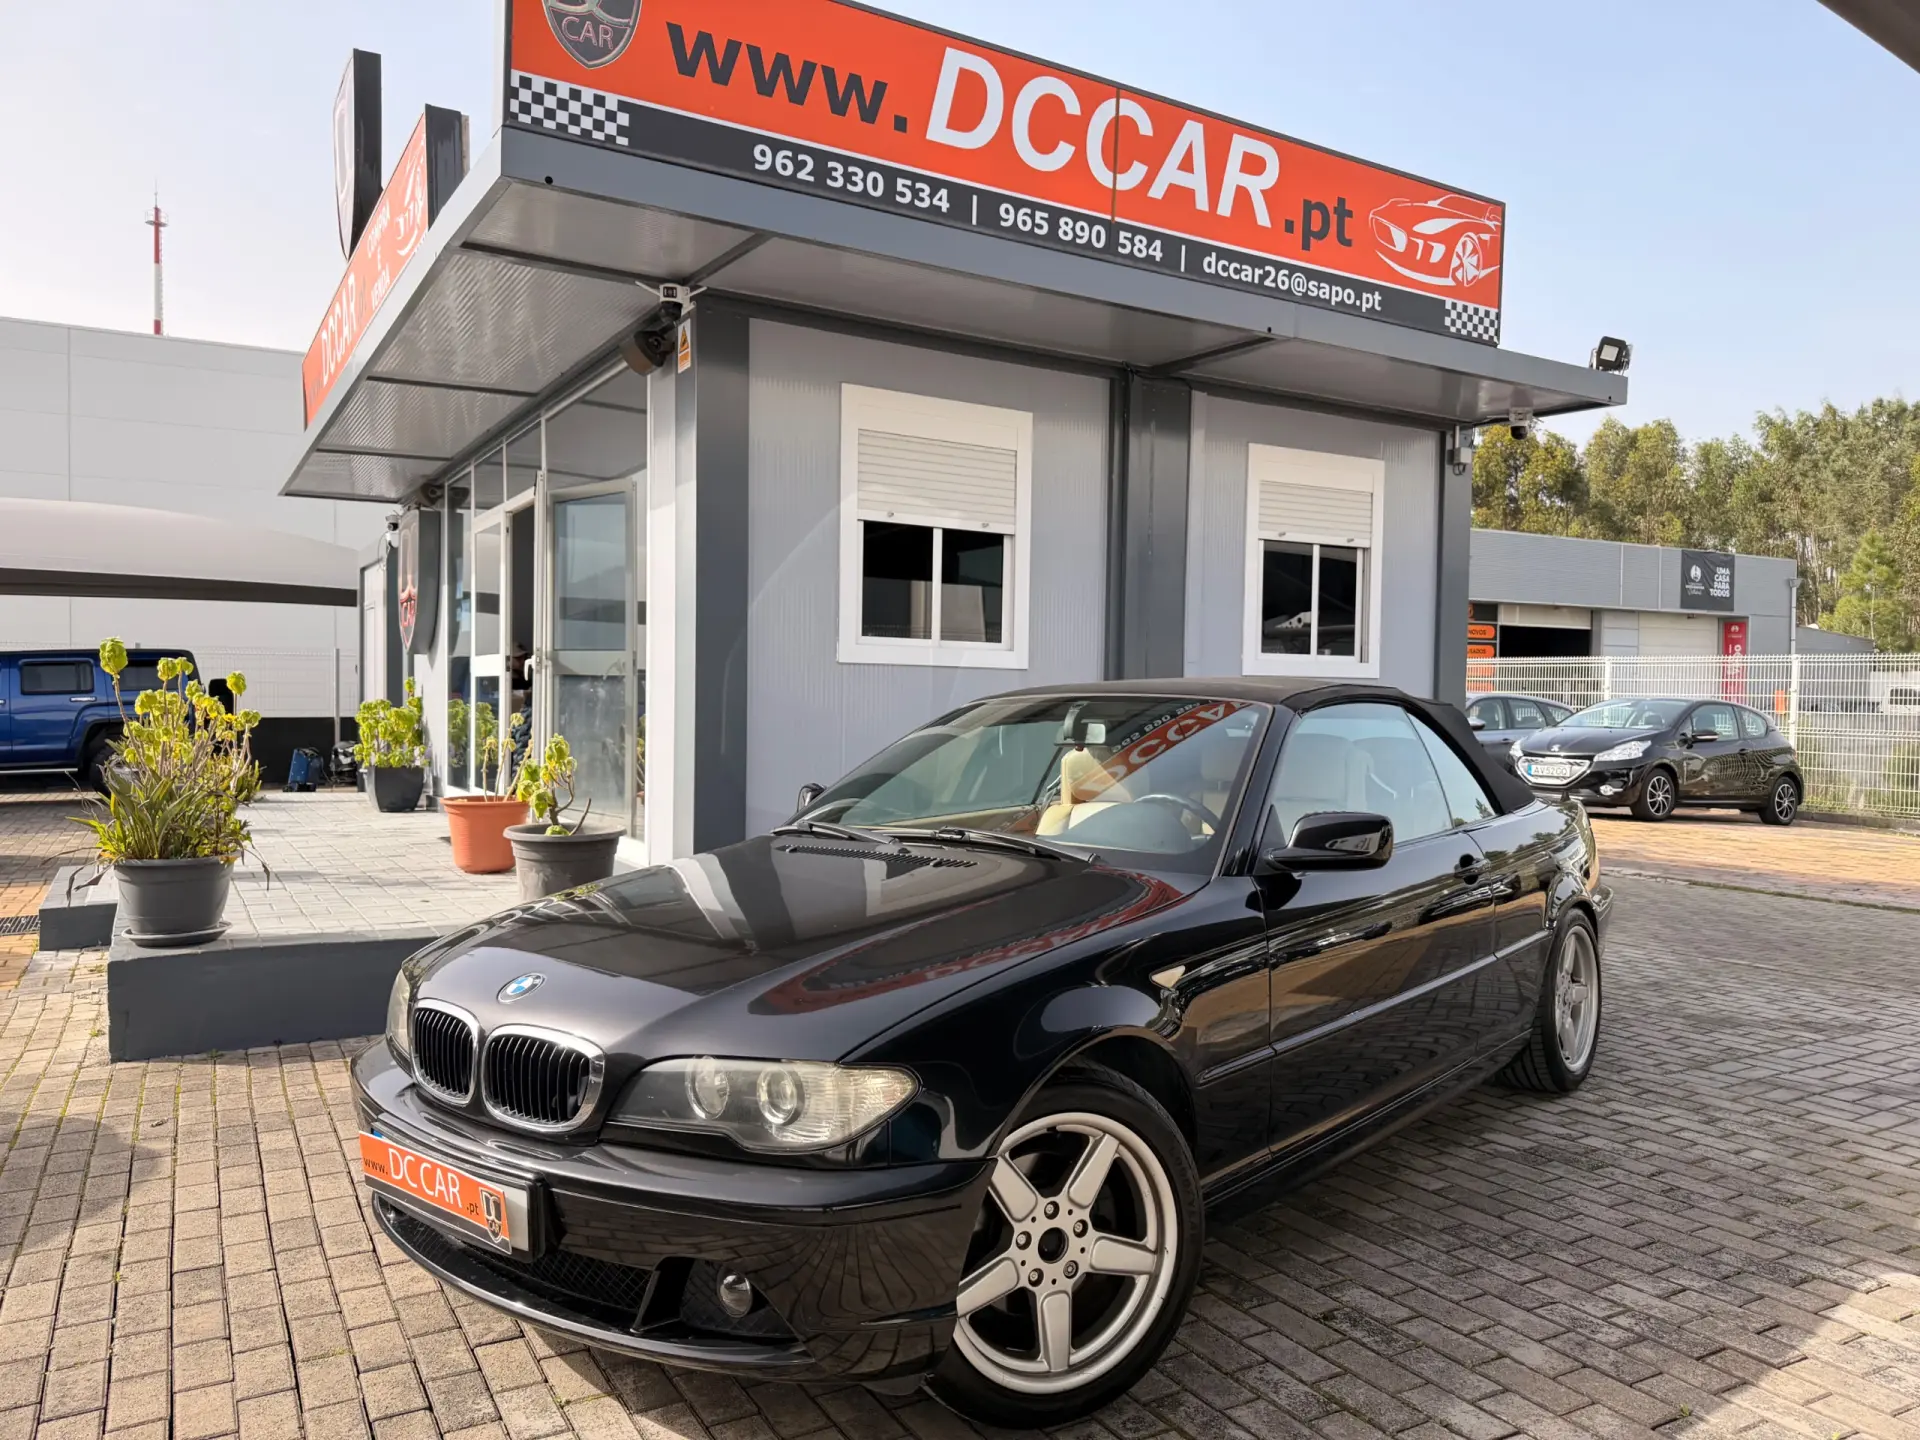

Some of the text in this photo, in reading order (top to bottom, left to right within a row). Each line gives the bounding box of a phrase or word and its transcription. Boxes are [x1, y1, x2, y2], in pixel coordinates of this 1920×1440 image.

[561, 16, 614, 50] CAR
[753, 143, 815, 183] 962
[826, 160, 884, 198] 330
[895, 179, 950, 214] 534
[999, 204, 1049, 237] 965
[1058, 217, 1107, 250] 890
[1117, 231, 1163, 263] 584
[1202, 252, 1382, 313] dccar26@sapo.pt
[1716, 566, 1730, 575] UMA
[1714, 574, 1730, 583] CASA
[1713, 582, 1730, 590] PARA
[1709, 589, 1730, 598] TODOS
